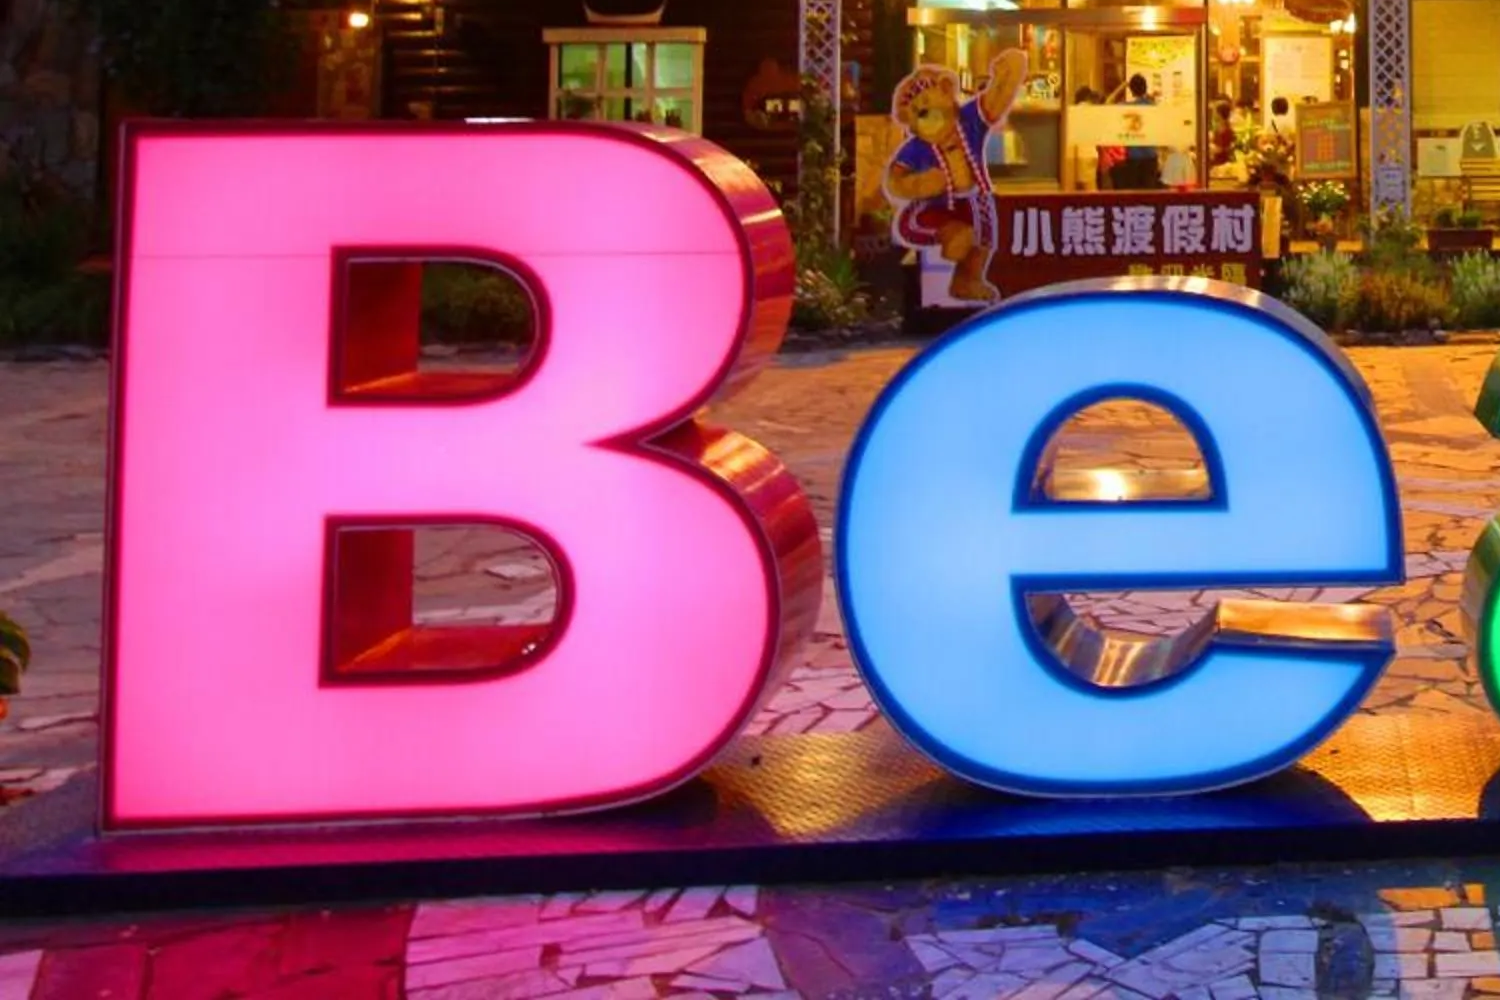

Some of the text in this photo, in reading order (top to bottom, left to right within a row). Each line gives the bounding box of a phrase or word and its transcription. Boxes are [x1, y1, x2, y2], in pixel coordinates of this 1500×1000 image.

[1011, 204, 1255, 257] 小熊渡假村
